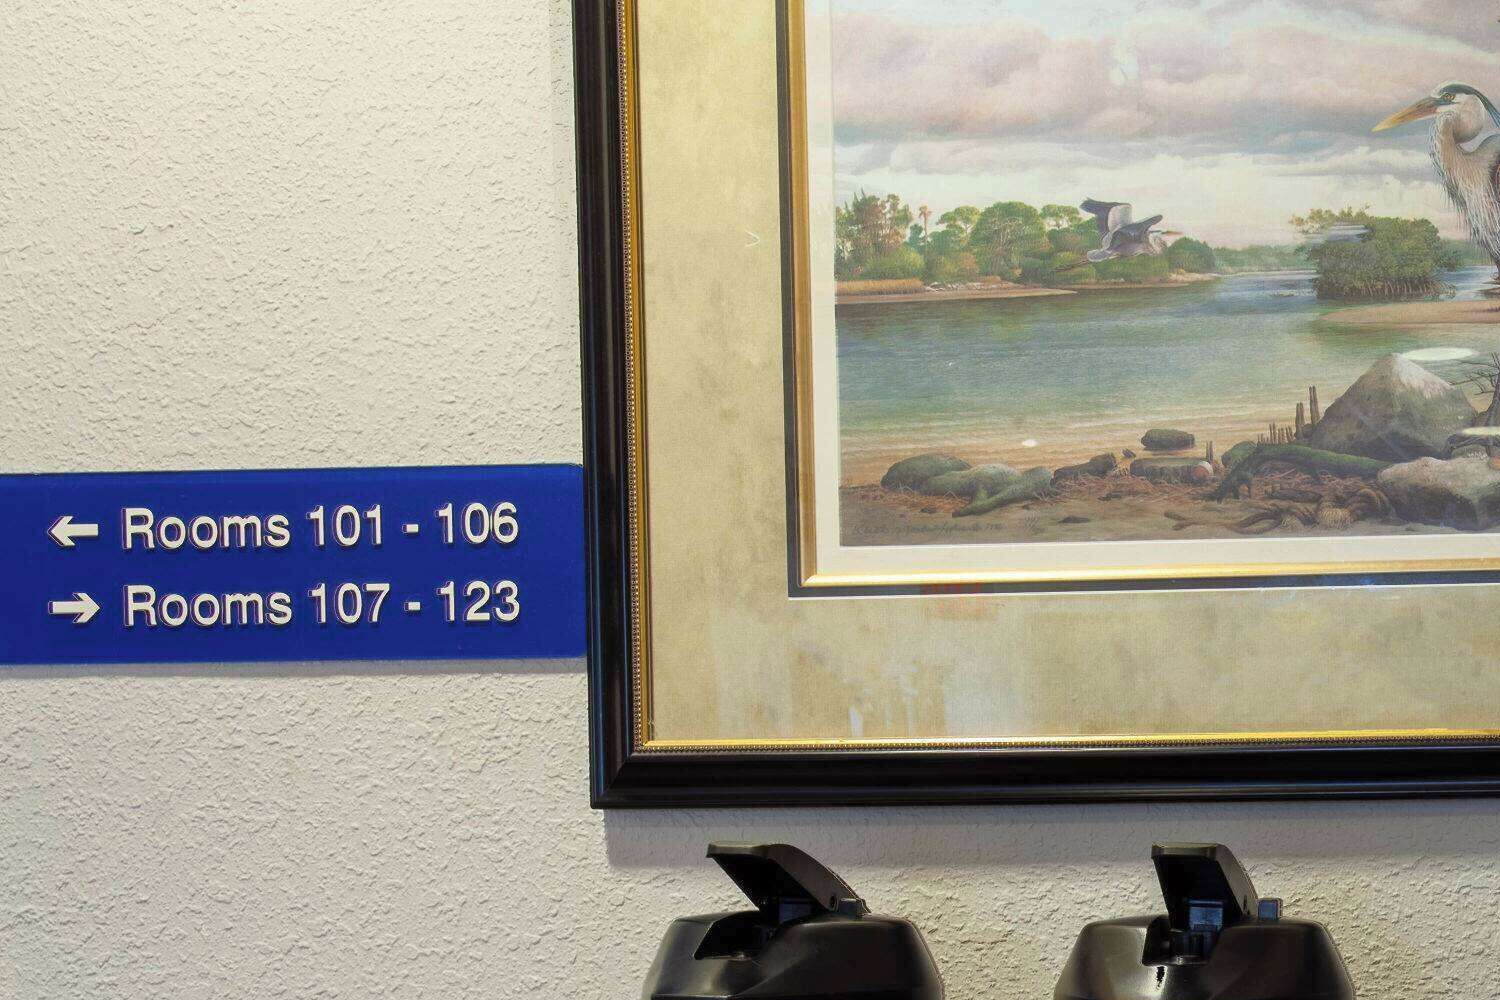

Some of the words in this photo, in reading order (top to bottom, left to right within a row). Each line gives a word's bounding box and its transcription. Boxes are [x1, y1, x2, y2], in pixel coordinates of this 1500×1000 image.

[121, 507, 291, 550] Rooms
[306, 504, 384, 547] 101
[435, 501, 520, 545] 106
[122, 584, 293, 627] Rooms
[308, 582, 391, 625] 107
[437, 580, 521, 622] 123
